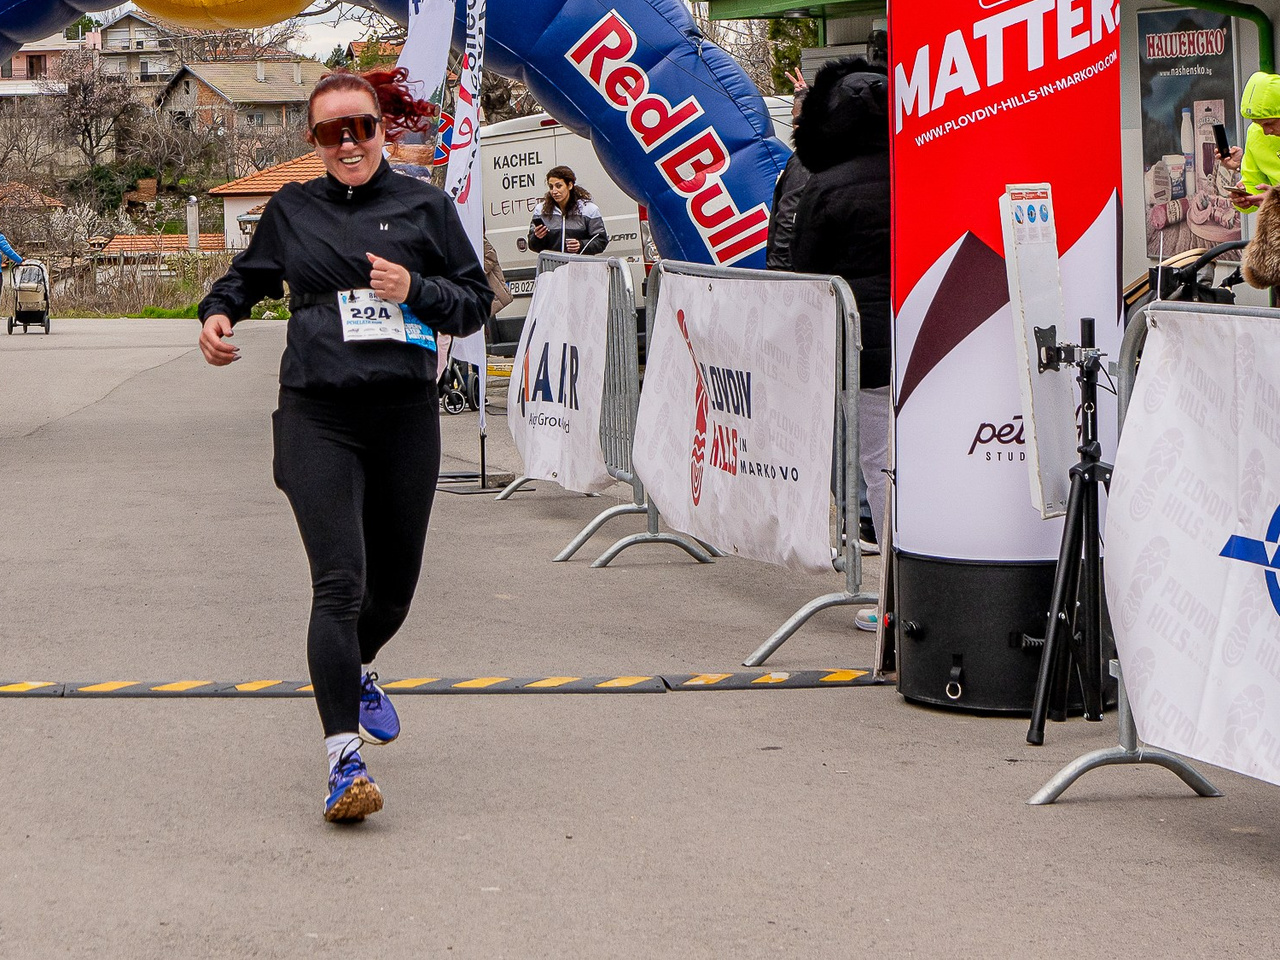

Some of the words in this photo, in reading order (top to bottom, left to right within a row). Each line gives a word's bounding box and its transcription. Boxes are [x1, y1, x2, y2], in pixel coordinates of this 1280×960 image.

[1159, 63, 1213, 77] www.nashensko.bg
[914, 49, 1118, 147] WWW.PLOVDIV-HILLS-IN-MARKOVO.COM
[570, 15, 699, 148] Red
[660, 131, 769, 264] Bull
[493, 151, 543, 170] KACHEL
[502, 173, 535, 190] ÖFEN
[350, 306, 392, 321] 224
[739, 437, 748, 453] IN
[985, 451, 1026, 462] STUD
[739, 459, 799, 482] MARKOVO
